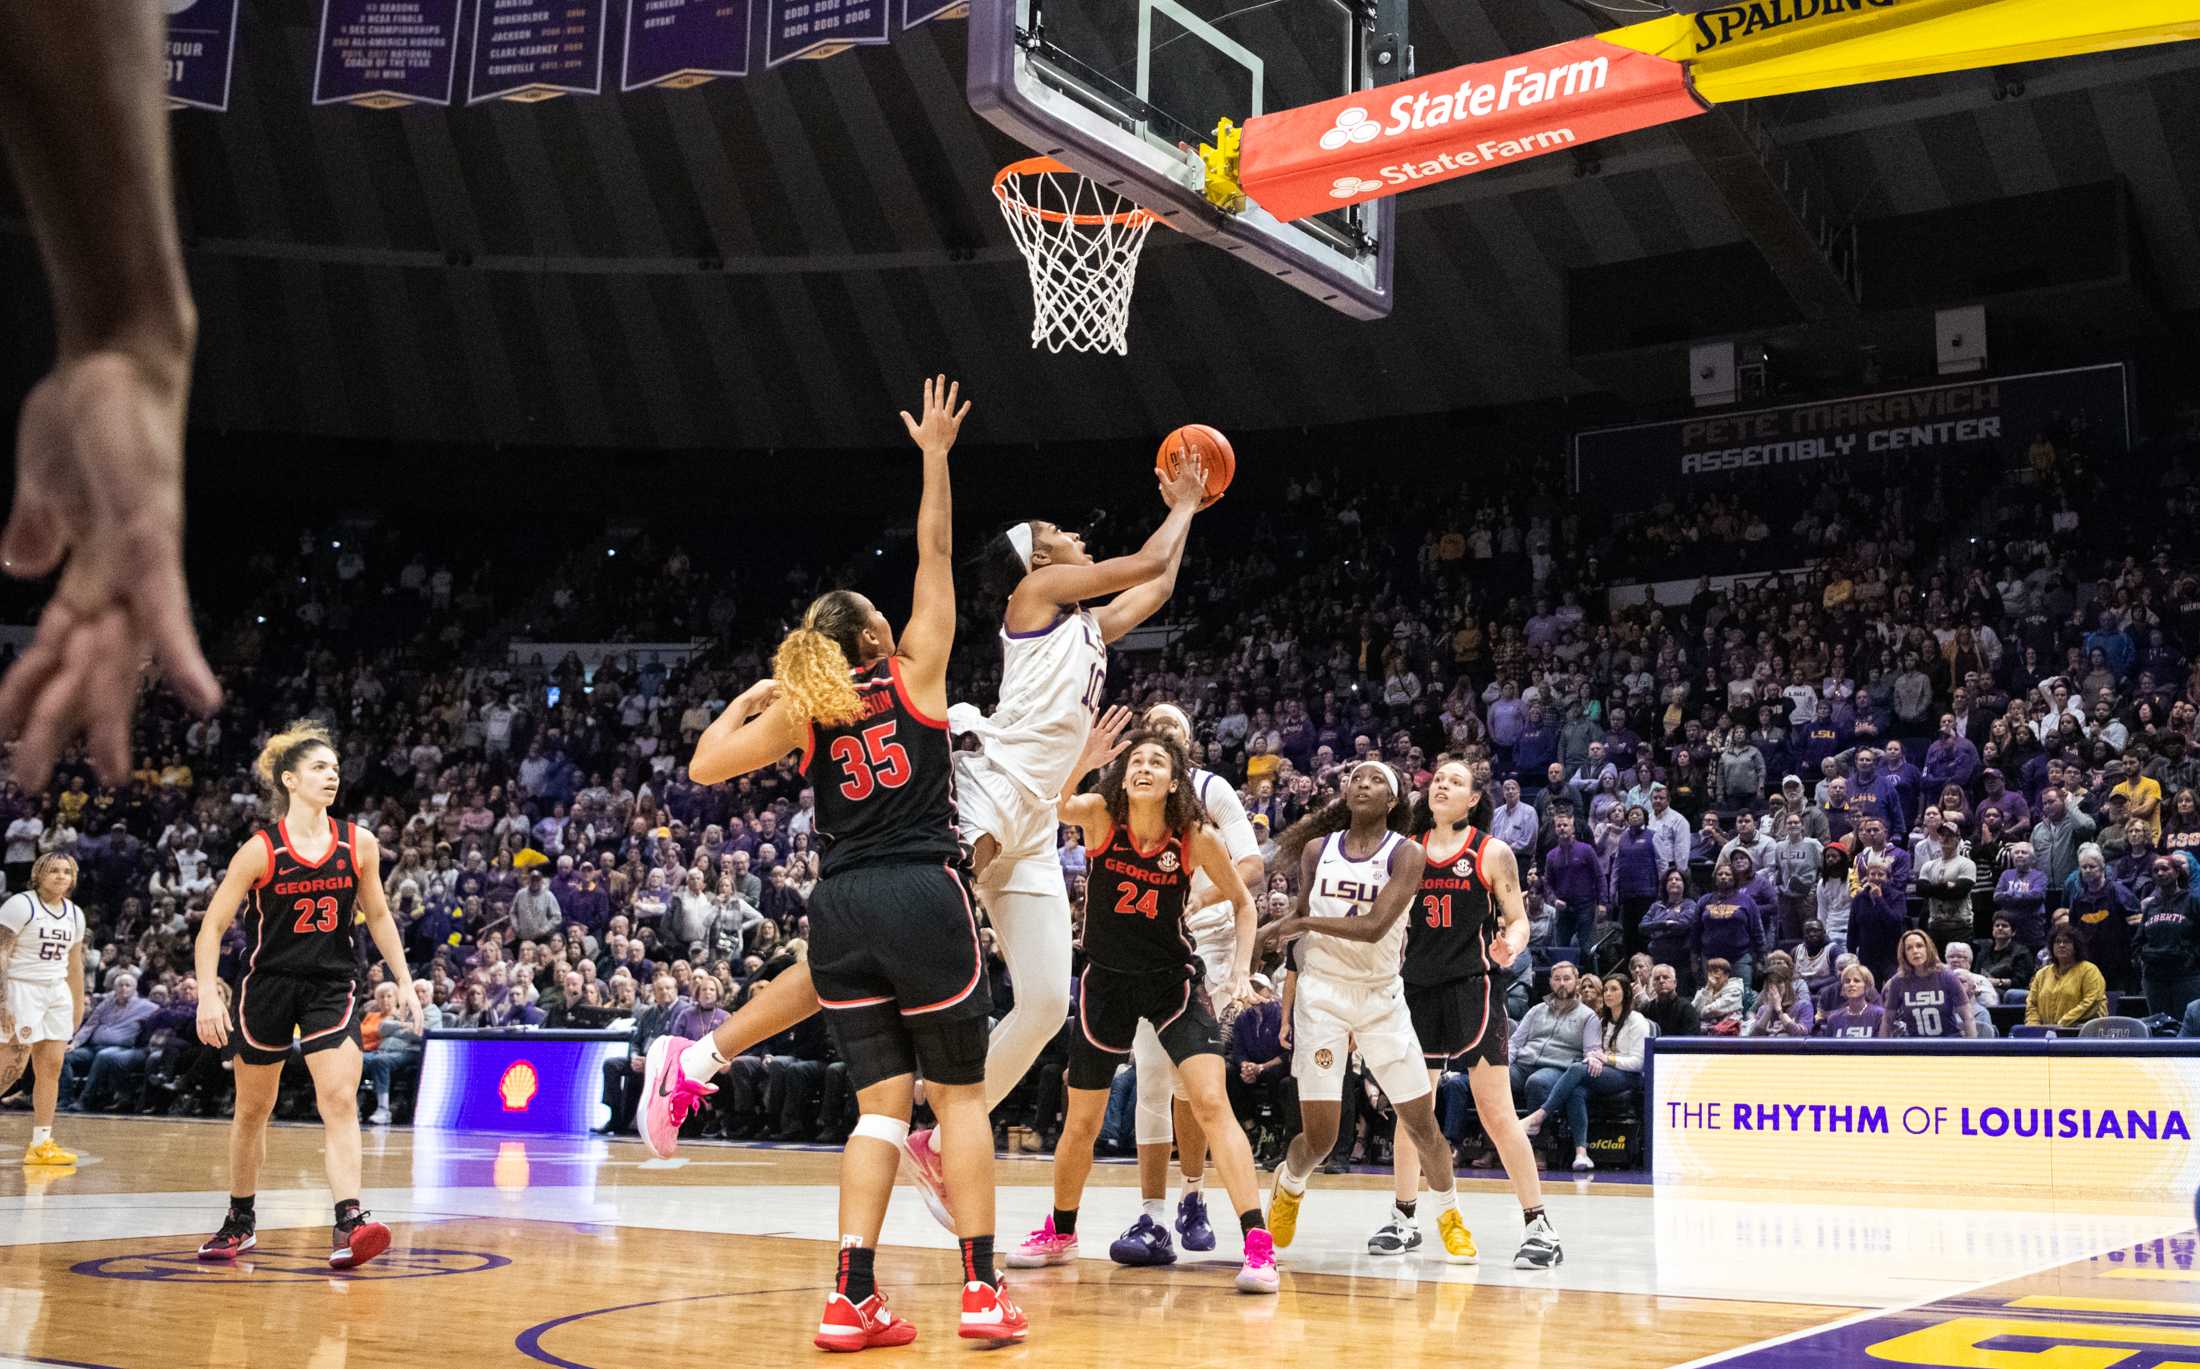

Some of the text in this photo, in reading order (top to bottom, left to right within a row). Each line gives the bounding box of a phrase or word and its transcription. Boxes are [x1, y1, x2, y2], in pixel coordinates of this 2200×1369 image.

[368, 25, 440, 34] CHAMPIONSHIPS
[491, 30, 532, 41] JACKSON
[1682, 384, 2000, 447] PETE MARAVICH
[1682, 416, 2001, 474] ASSEMBLY CENTER
[1810, 730, 1836, 740] LSU
[831, 720, 912, 801] 35
[1780, 850, 1806, 860] LSU
[1104, 858, 1178, 885] GEORGIA
[275, 876, 353, 895] GEORGIA
[1320, 878, 1379, 903] LSU
[1114, 881, 1159, 919] 24
[1423, 894, 1452, 928] 31
[293, 896, 338, 934] 23
[39, 927, 72, 942] LSU
[1904, 990, 1945, 1006] LSU
[1835, 1026, 1873, 1038] LSU
[1912, 1008, 1943, 1036] 10
[1666, 1101, 2192, 1141] THE RHYTHM OF LOUISIANA
